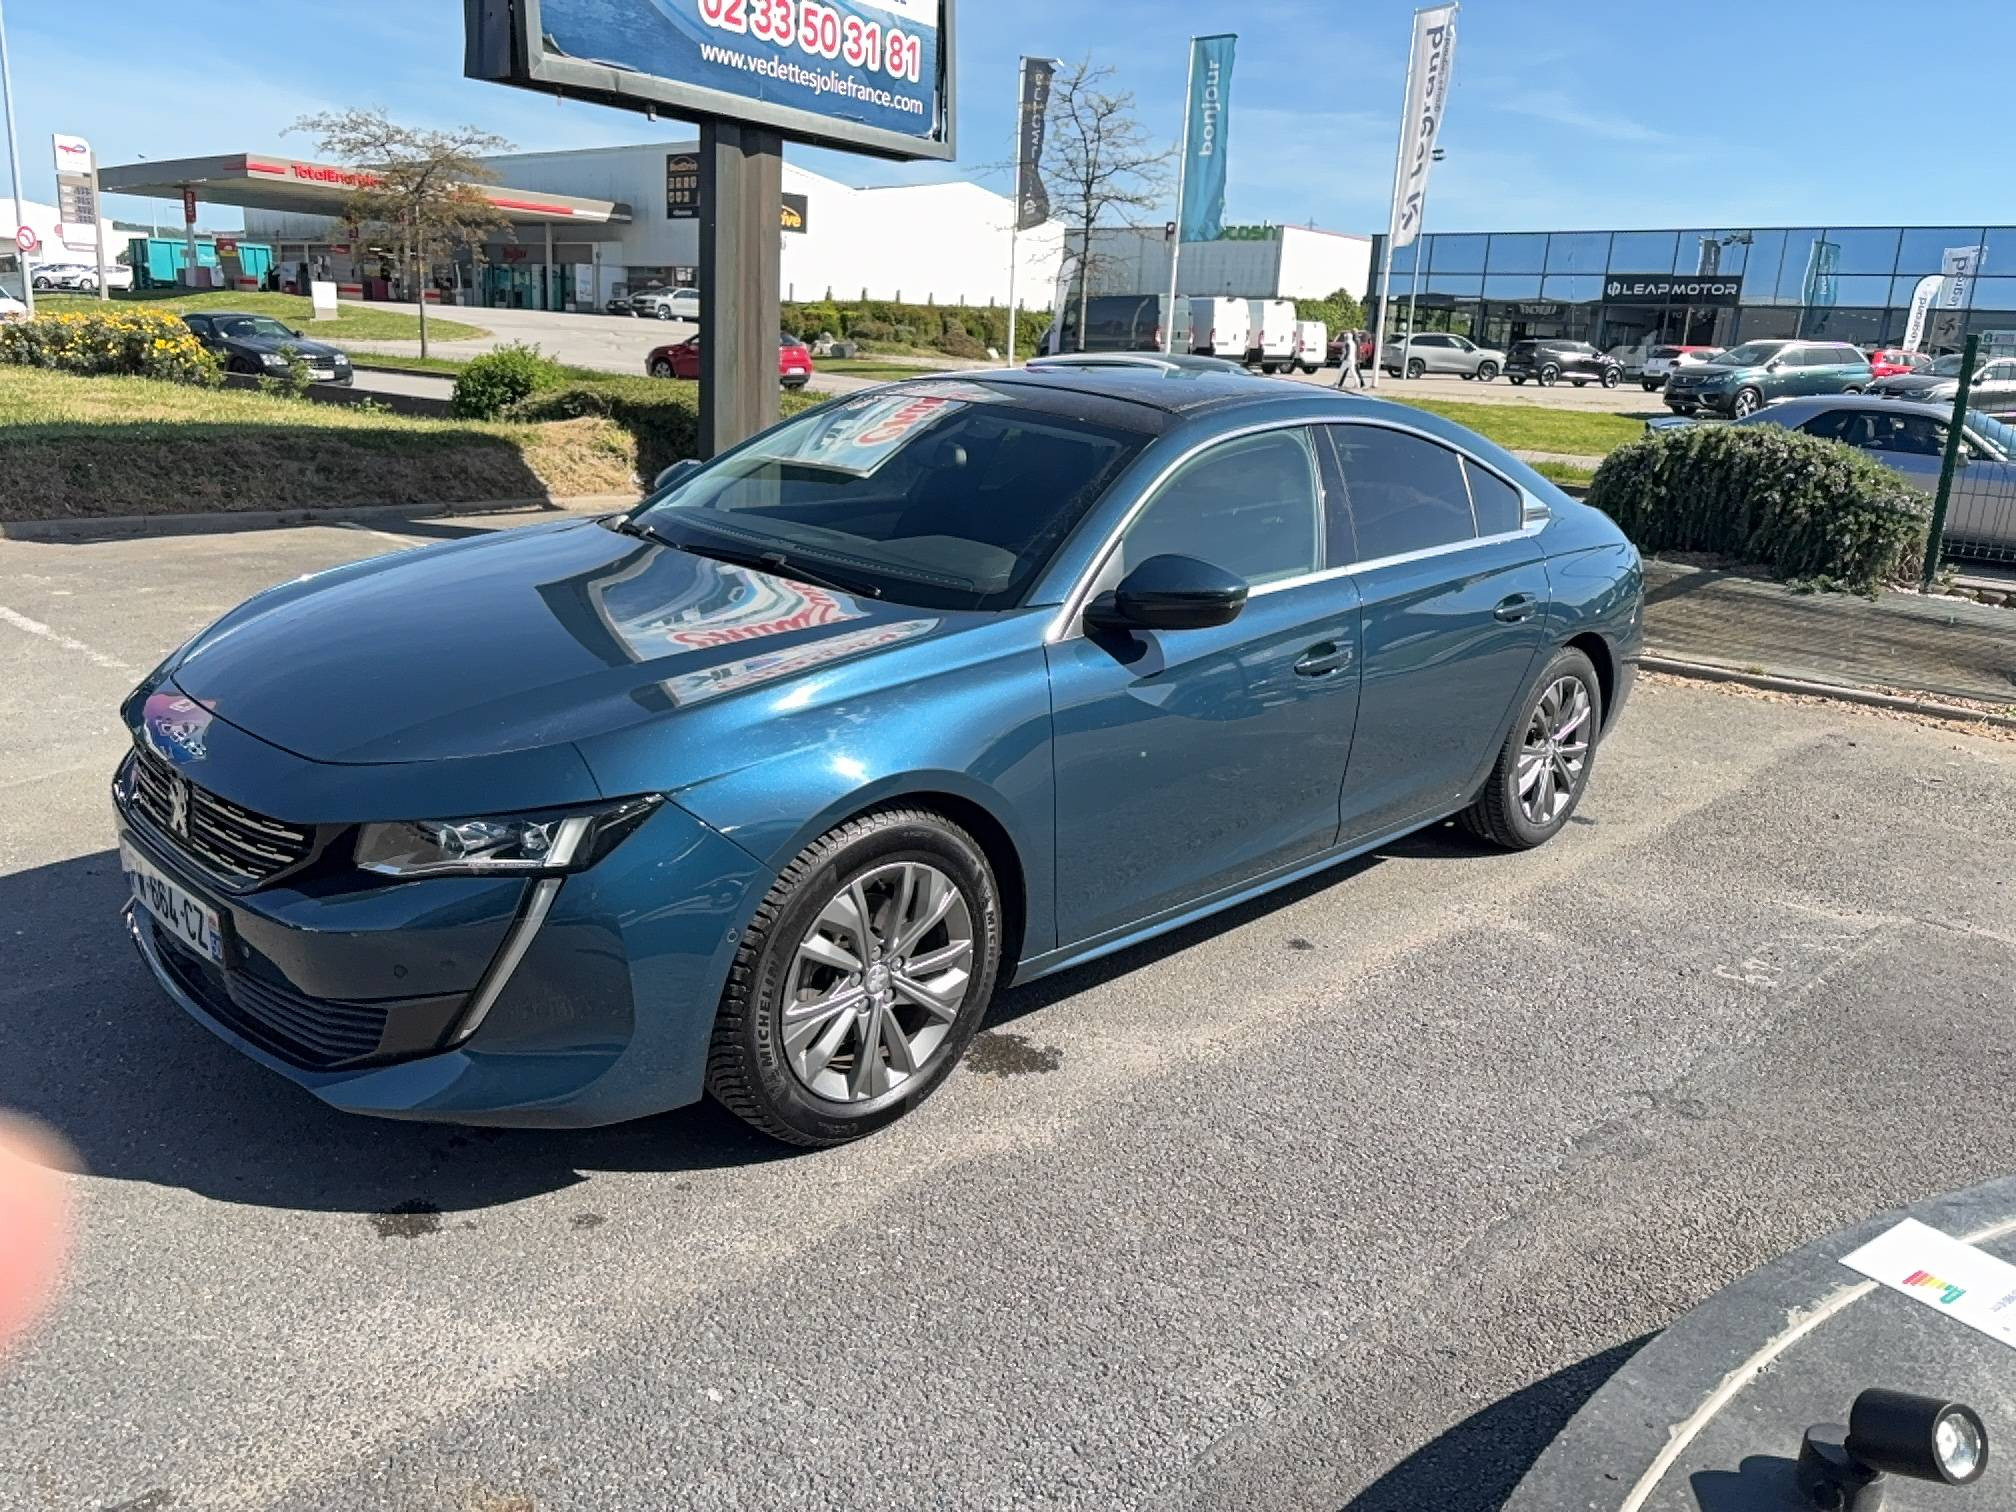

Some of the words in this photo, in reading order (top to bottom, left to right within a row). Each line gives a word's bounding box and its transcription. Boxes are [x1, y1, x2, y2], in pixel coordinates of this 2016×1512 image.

[700, 43, 923, 115] www.vedettesjoliefrance.com
[752, 0, 793, 42] 33
[799, 4, 839, 56] 50
[845, 18, 879, 68] 31
[887, 32, 919, 80] 81
[1199, 60, 1222, 156] bonjour
[290, 163, 383, 188] TotalEnergie
[758, 960, 778, 1067] MICHELIN
